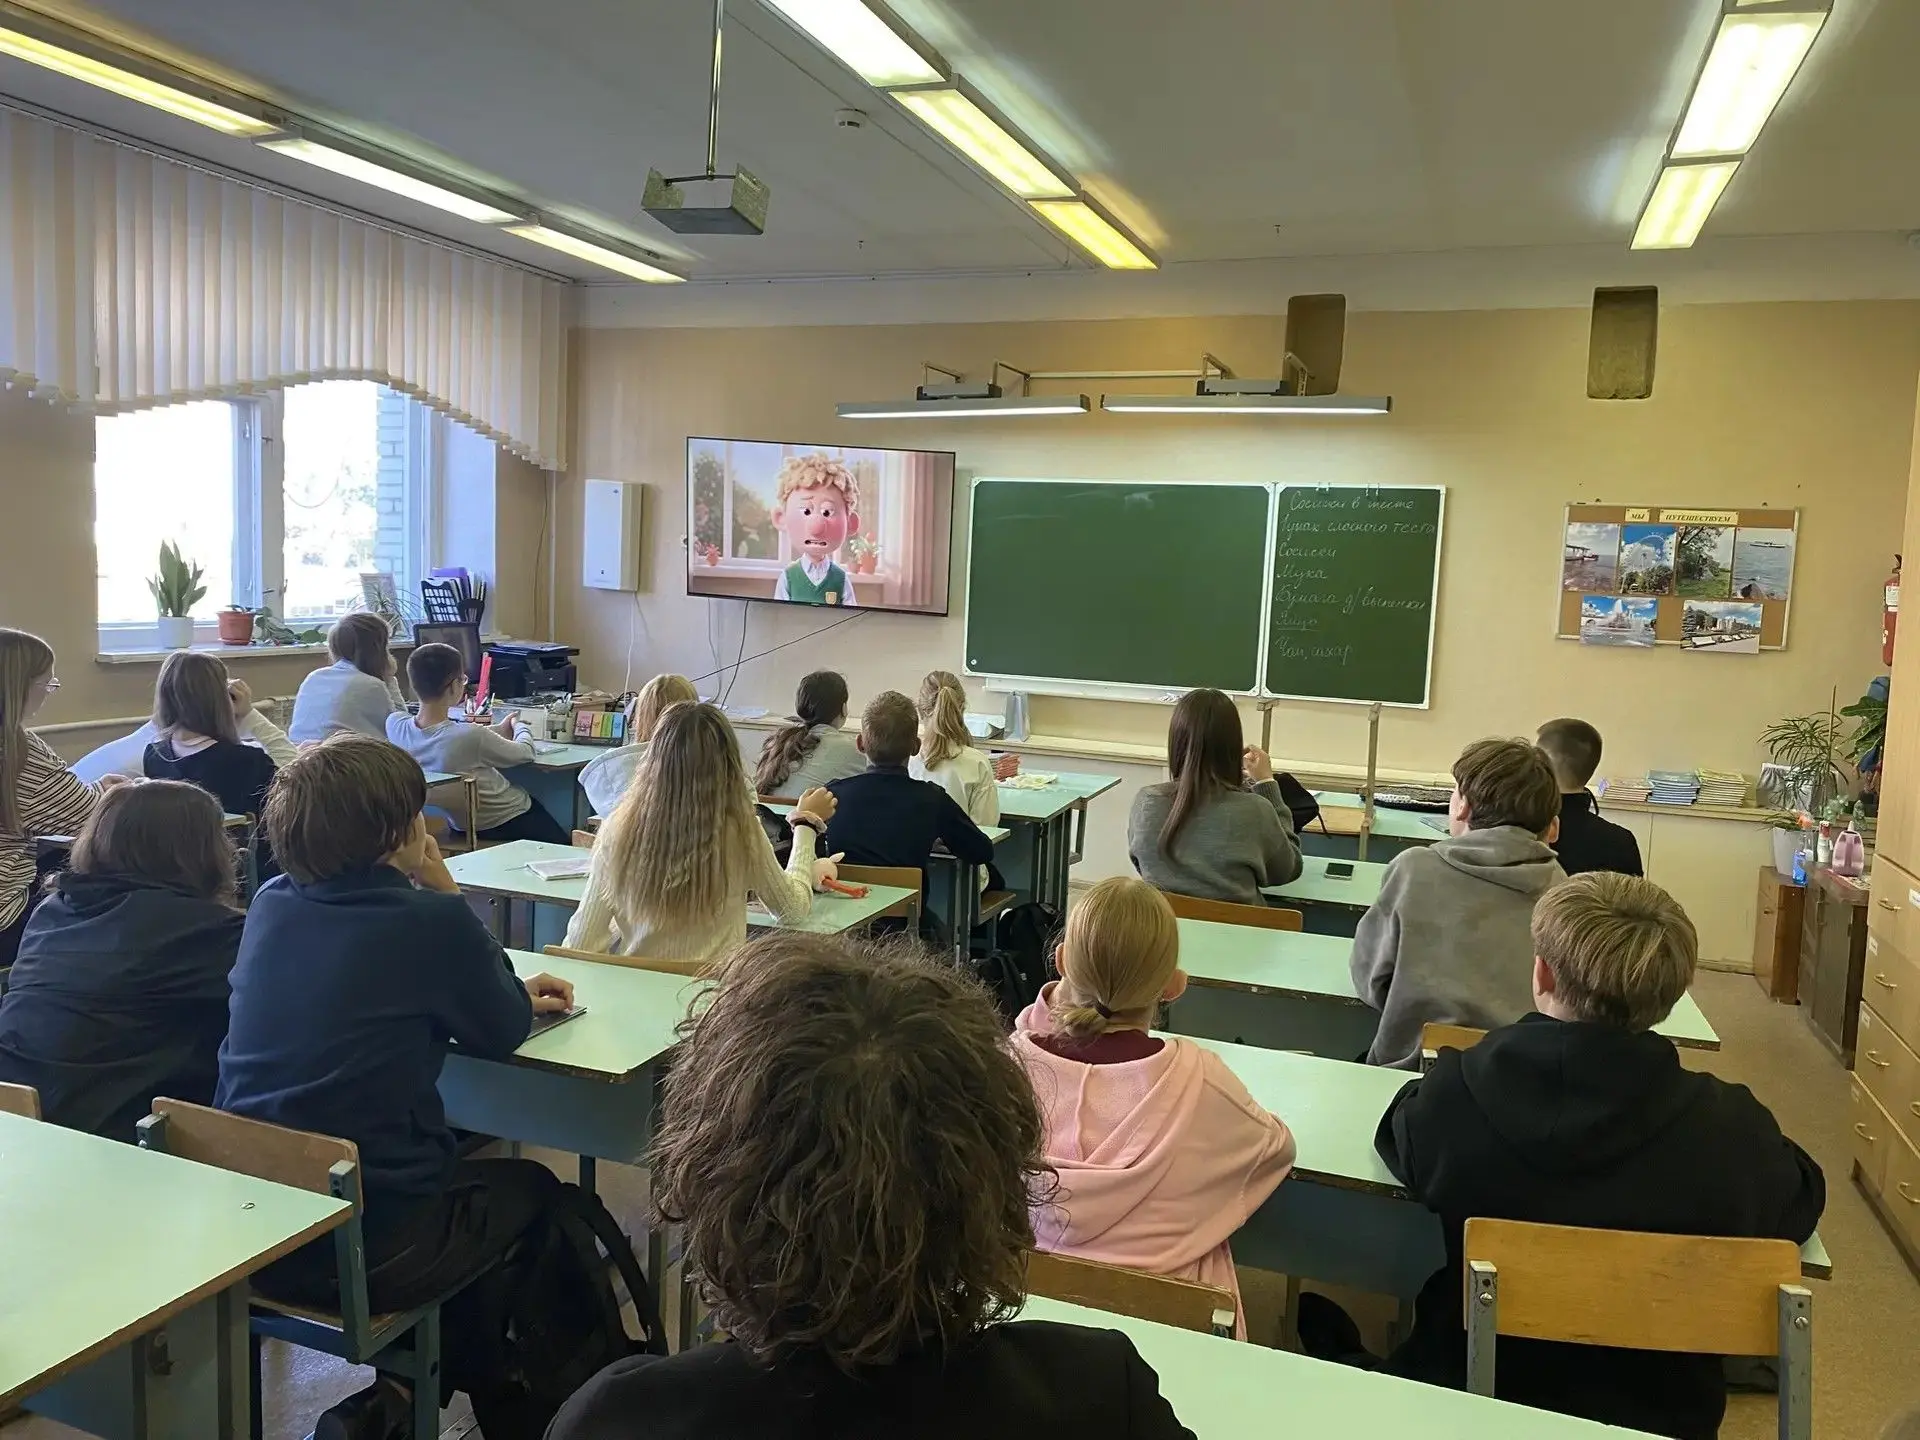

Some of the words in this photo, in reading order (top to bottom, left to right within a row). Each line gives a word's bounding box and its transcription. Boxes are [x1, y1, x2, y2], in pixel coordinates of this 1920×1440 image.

[1351, 495, 1361, 509] в
[1665, 514, 1731, 523] ПУТЕШЕСТВУЕМ
[1276, 564, 1328, 589] Мука
